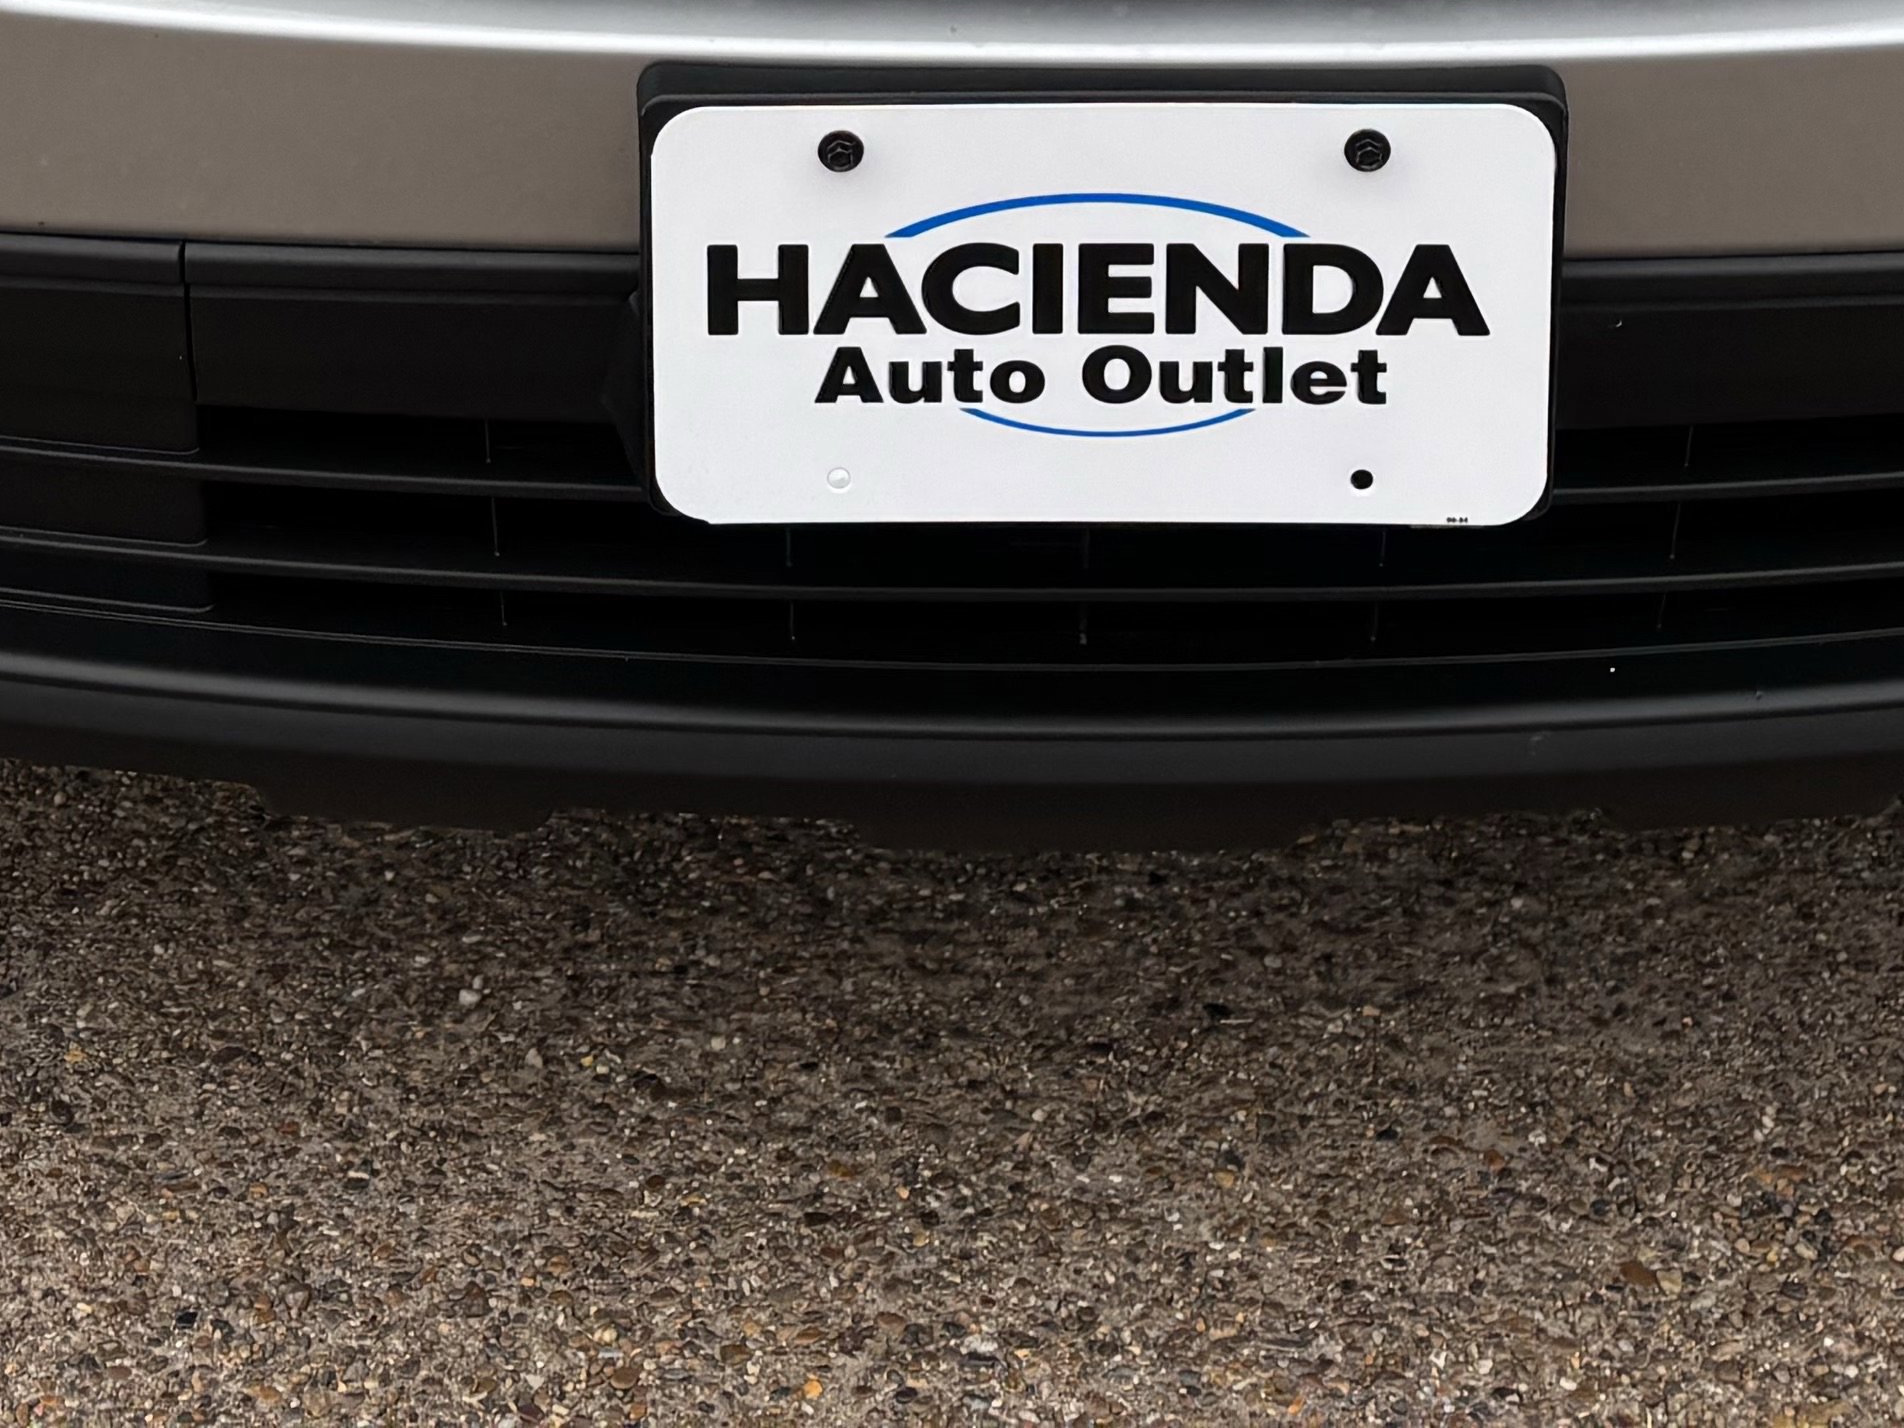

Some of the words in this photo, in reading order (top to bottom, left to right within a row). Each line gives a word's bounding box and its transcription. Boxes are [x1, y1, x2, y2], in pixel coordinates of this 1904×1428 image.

[705, 242, 1491, 337] HACIENDA
[813, 346, 1046, 405] Auto
[1081, 345, 1388, 406] Outlet
